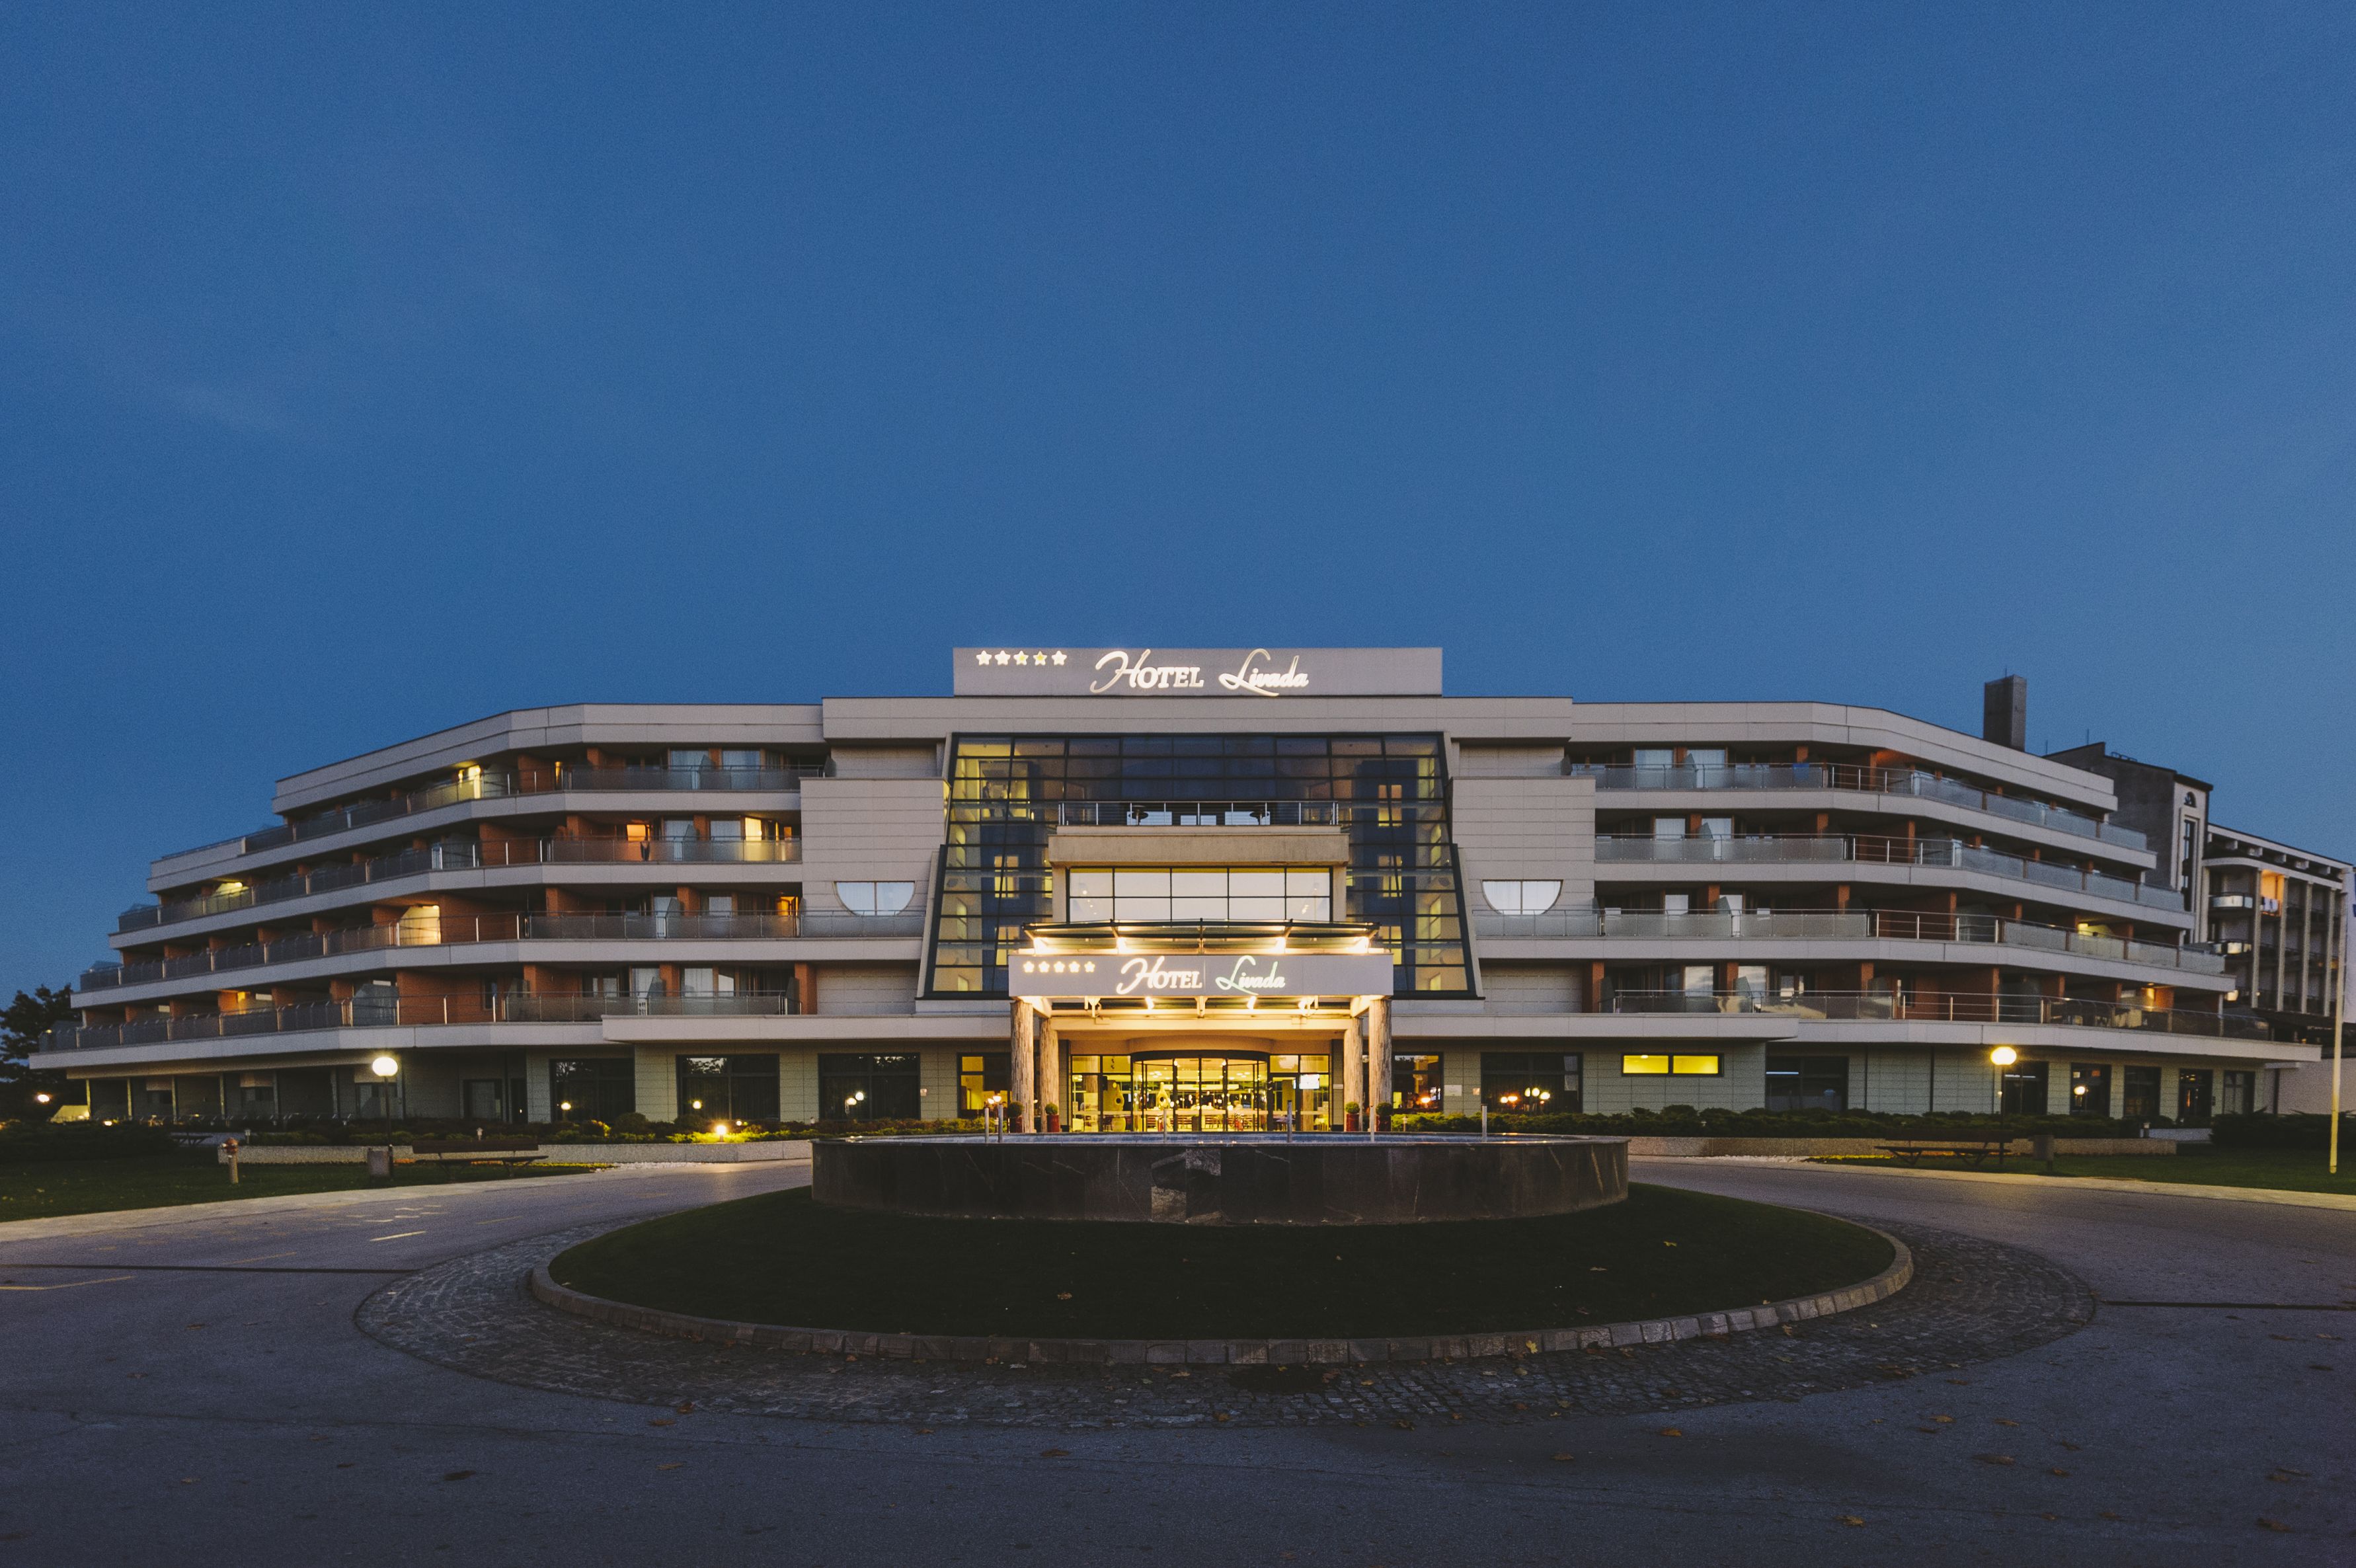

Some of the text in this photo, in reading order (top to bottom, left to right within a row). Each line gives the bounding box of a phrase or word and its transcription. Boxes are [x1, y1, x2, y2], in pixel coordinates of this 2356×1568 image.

[1090, 648, 1309, 696] HOTEL Livada
[1117, 955, 1286, 996] HOTEL Livada
